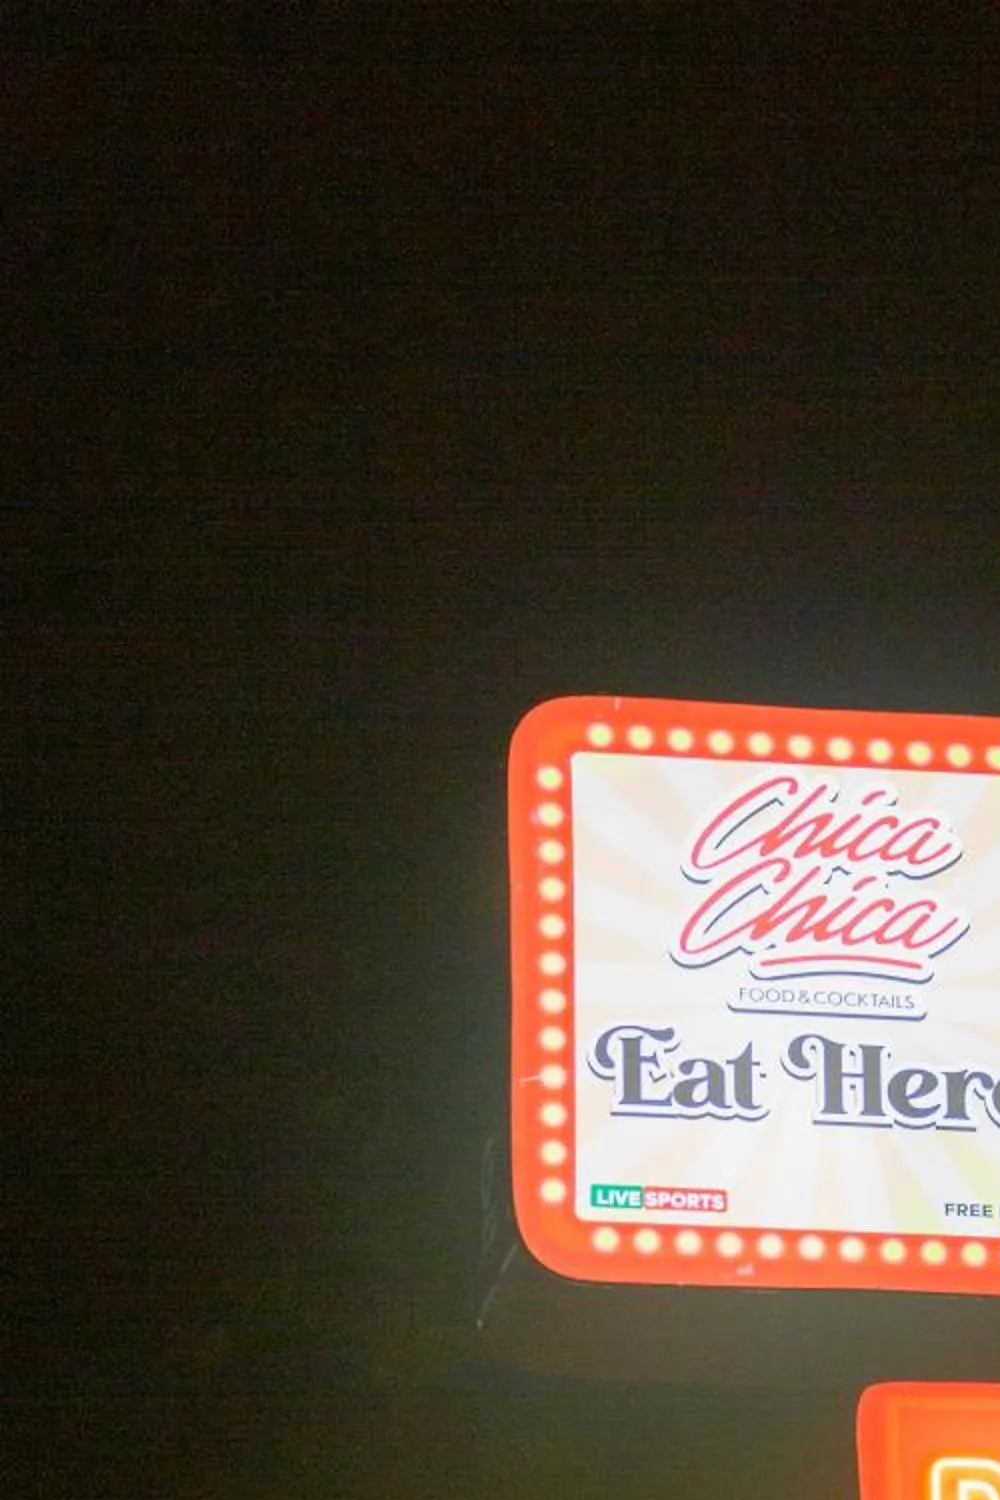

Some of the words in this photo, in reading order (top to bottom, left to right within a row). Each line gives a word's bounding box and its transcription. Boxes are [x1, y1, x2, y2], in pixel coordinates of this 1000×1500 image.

[691, 776, 952, 870] Chica
[680, 857, 957, 954] Chica
[592, 1025, 763, 1115] Eat
[596, 1189, 641, 1207] LIVE
[645, 1192, 725, 1210] SPORTS
[945, 1203, 993, 1217] FREE
